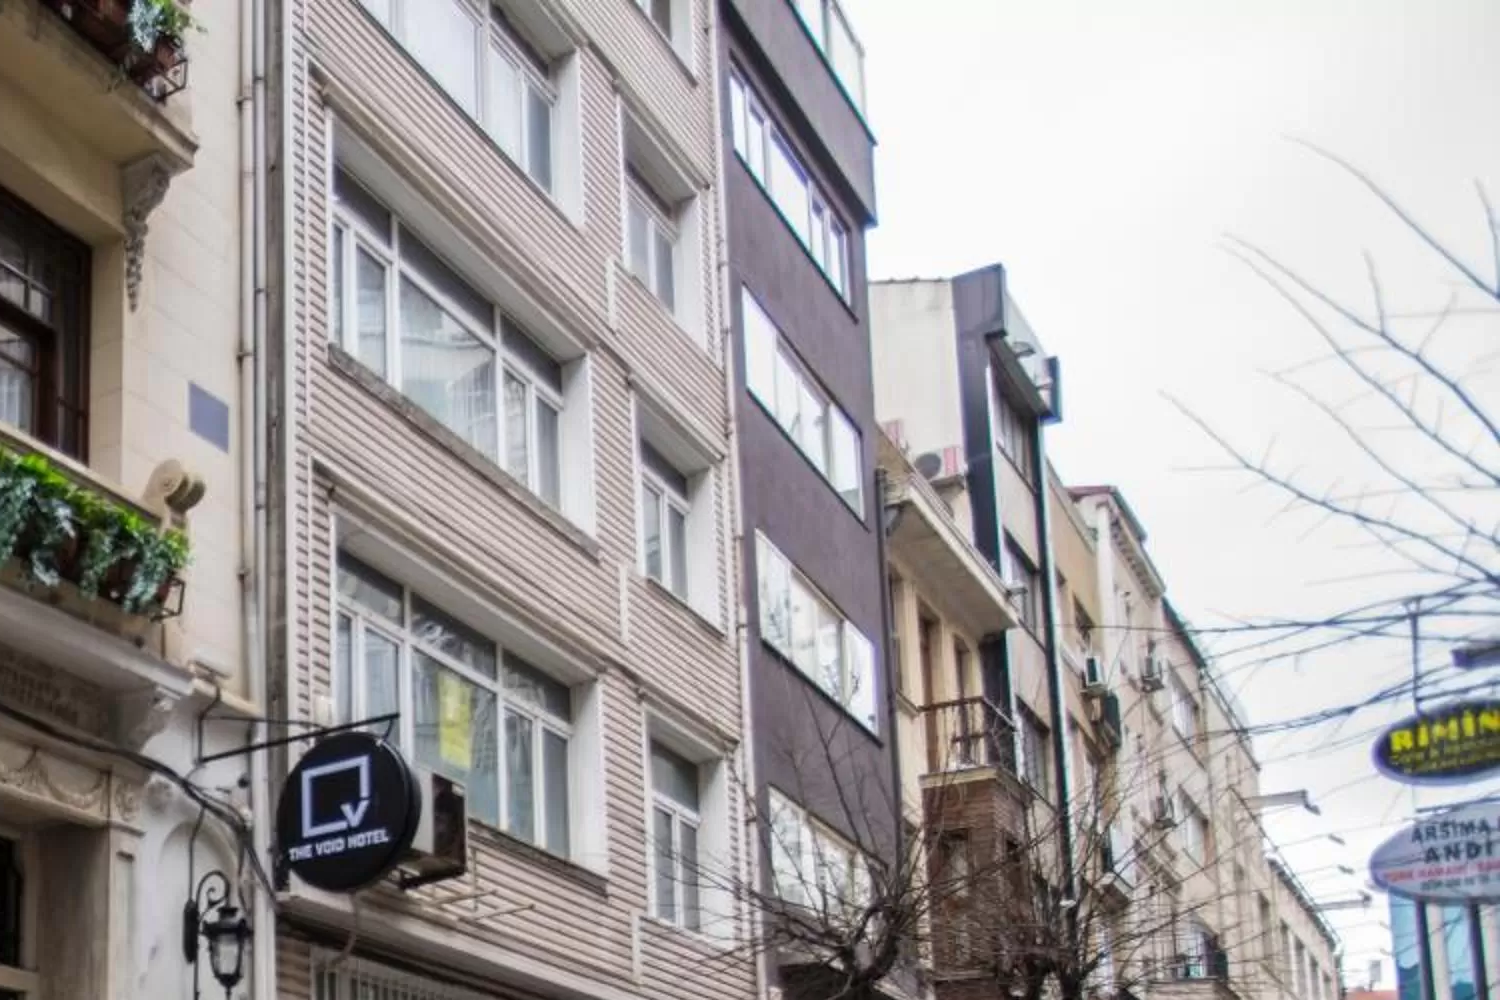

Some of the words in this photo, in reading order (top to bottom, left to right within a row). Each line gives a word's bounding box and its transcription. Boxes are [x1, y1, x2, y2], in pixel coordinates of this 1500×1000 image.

[289, 844, 312, 861] THE
[315, 837, 345, 856] VOID
[347, 828, 389, 849] HOTEL
